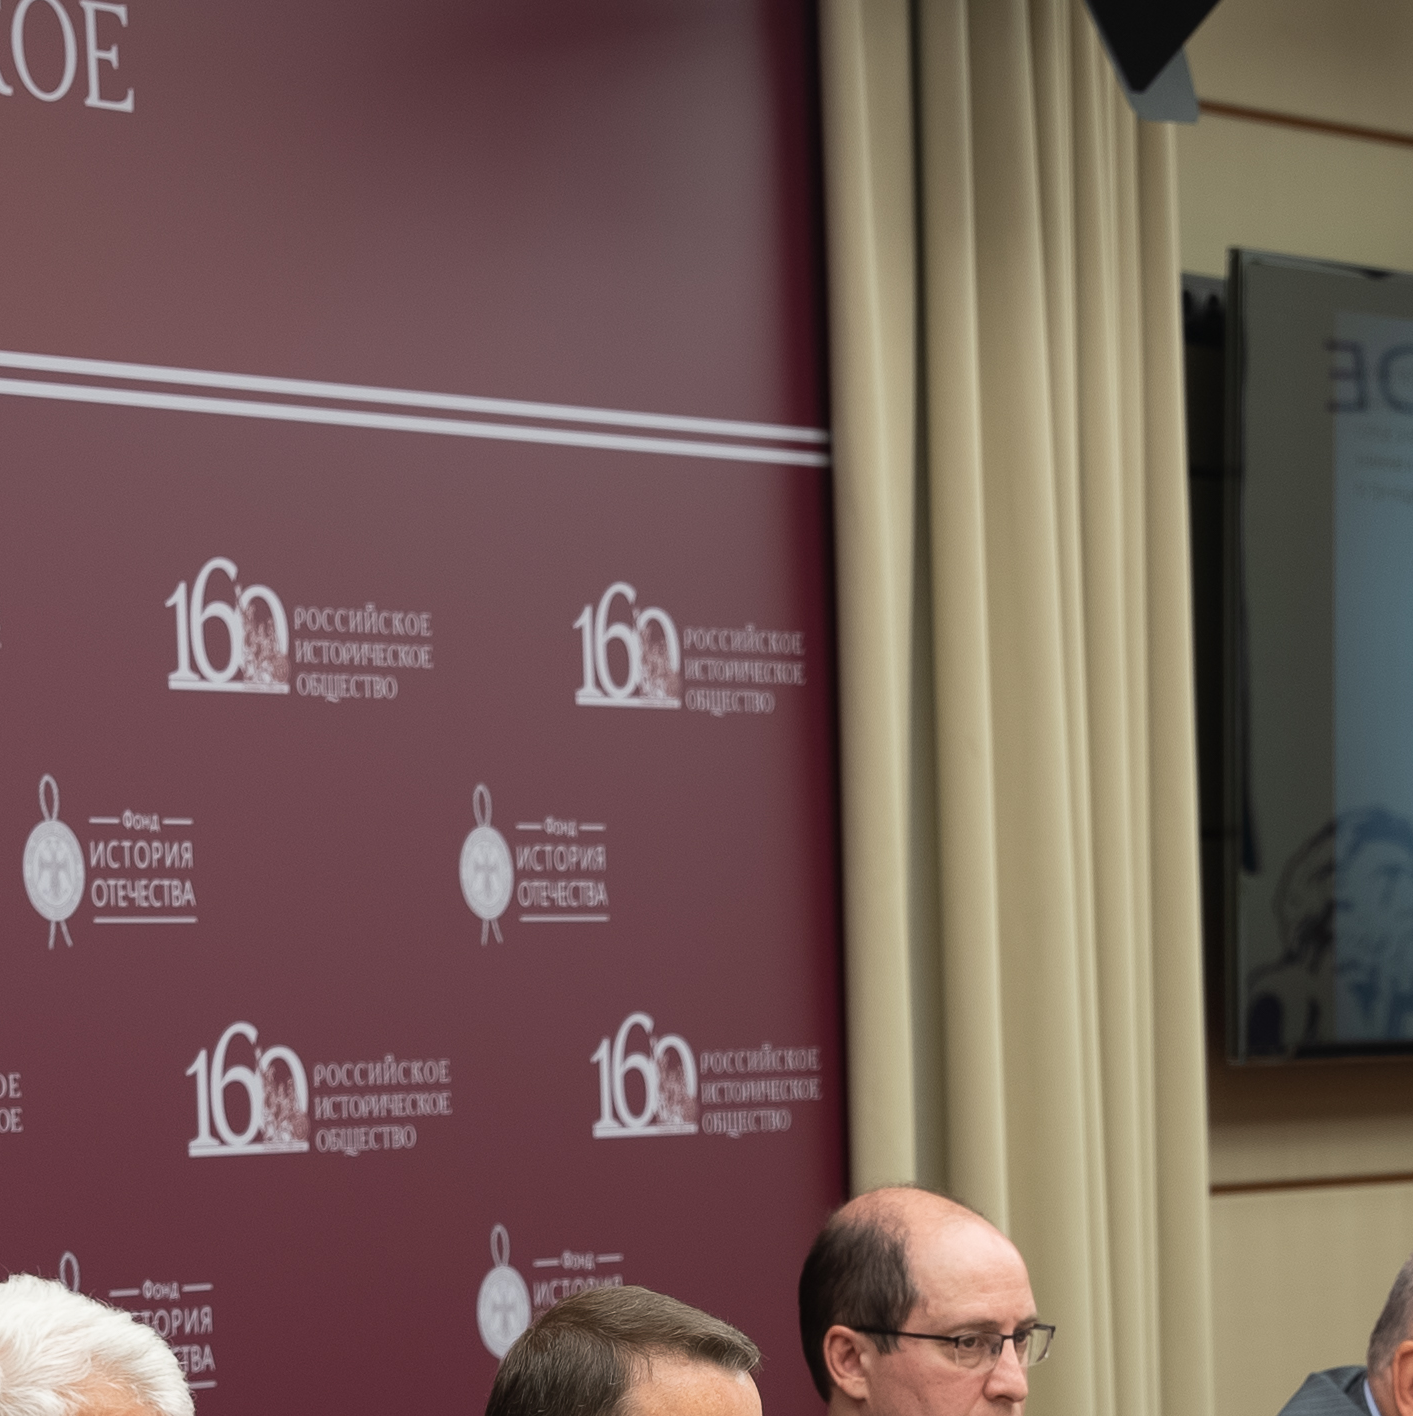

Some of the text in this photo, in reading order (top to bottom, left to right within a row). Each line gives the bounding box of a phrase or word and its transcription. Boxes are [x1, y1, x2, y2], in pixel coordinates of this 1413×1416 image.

[294, 602, 433, 636] РОССИЙСКОЕ
[295, 638, 433, 669] ИСТОРИЧЕСКОЕ
[297, 673, 398, 703] ОБЩЕСТВО
[122, 809, 161, 833] Фонд
[89, 840, 194, 869] ИСТОРИЯ
[91, 879, 197, 907] ОТЕЧЕСТВА
[313, 1052, 451, 1088] РОССИЙСКОЕ
[314, 1090, 453, 1120] ИСТОРИЧЕСКОЕ
[315, 1124, 417, 1157] ОБЩЕСТВО
[142, 1279, 180, 1301] Фонд
[132, 1305, 213, 1338] ТОРИЯ
